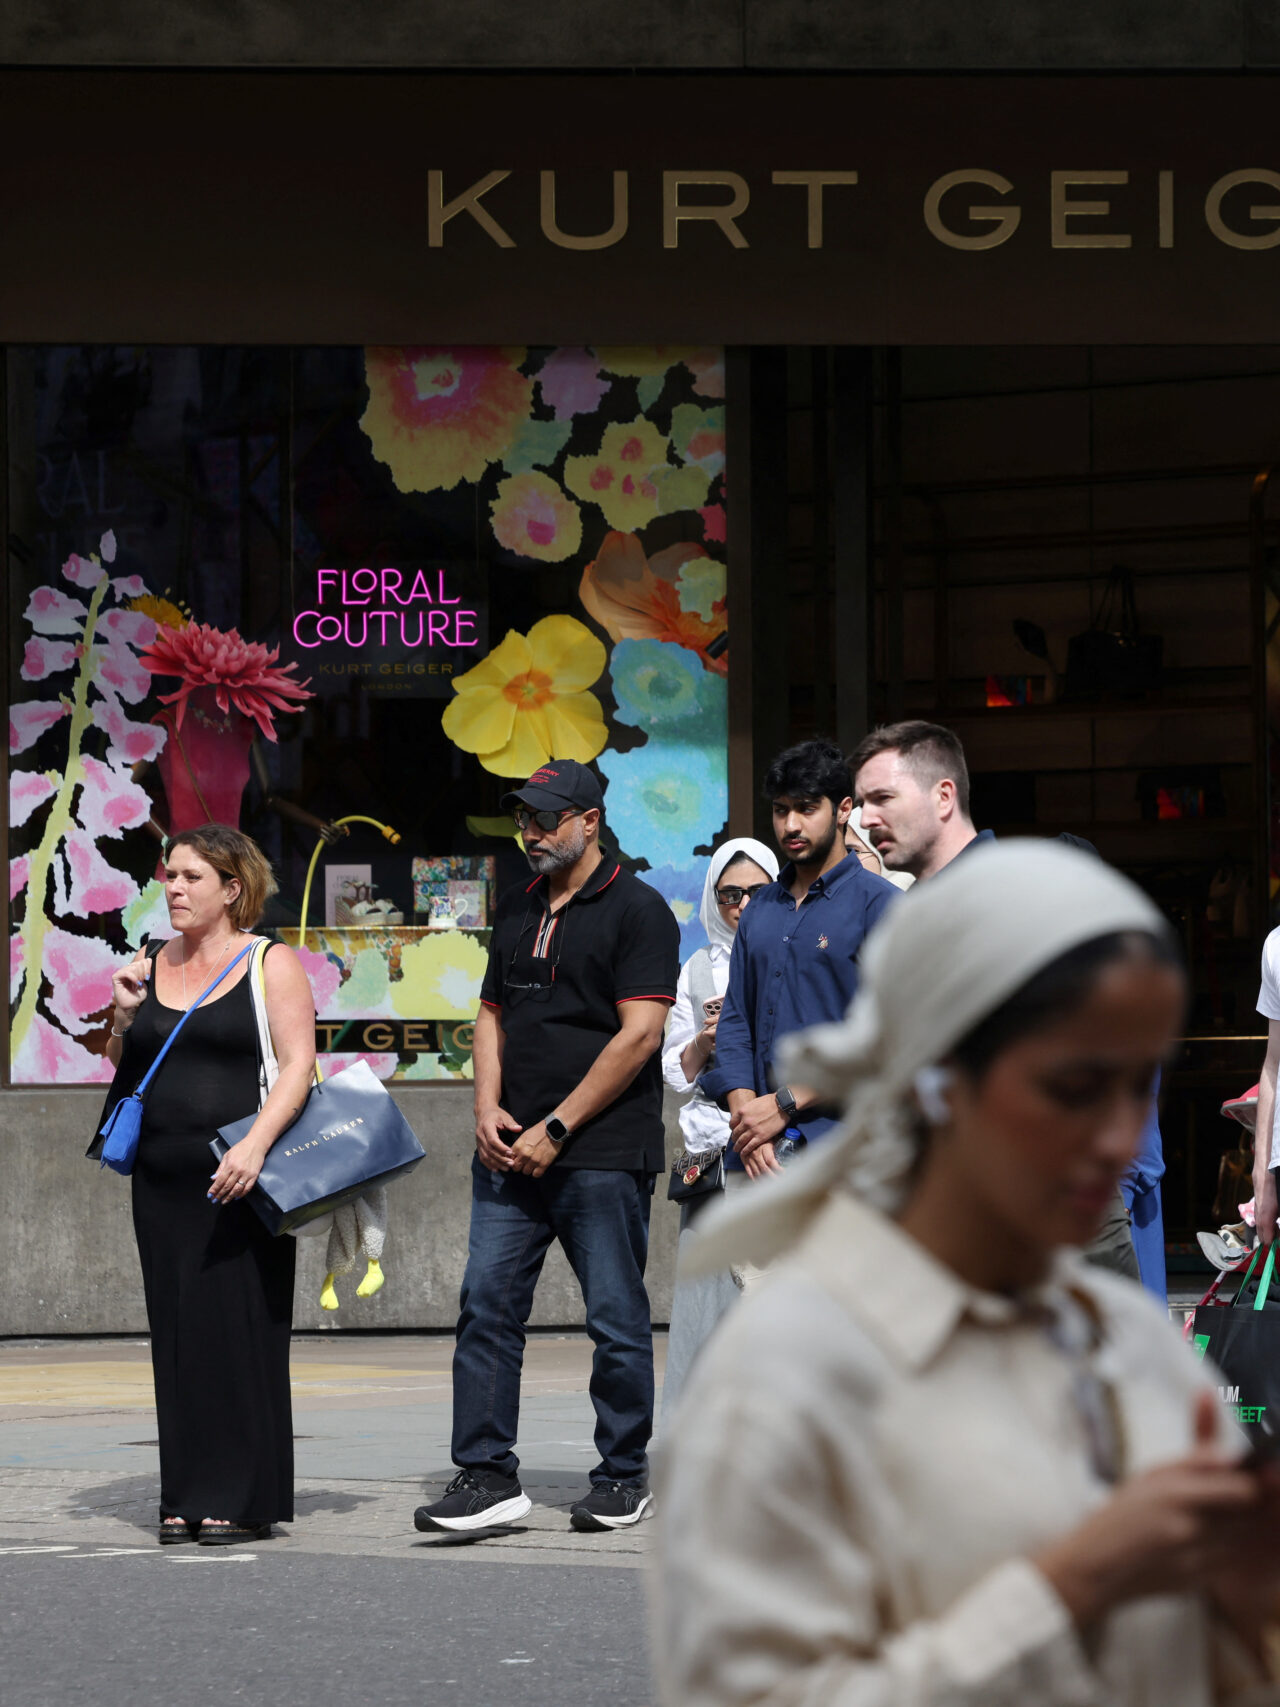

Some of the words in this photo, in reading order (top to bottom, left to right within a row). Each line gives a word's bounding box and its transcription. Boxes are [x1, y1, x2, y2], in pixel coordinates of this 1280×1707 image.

[427, 168, 859, 251] KURT
[317, 568, 461, 606] FLORAL
[293, 610, 478, 648] COUTURE
[318, 663, 371, 675] KURT
[379, 663, 453, 675] GEIGER
[284, 1139, 319, 1157] RALPH
[322, 1116, 365, 1141] LAUREN
